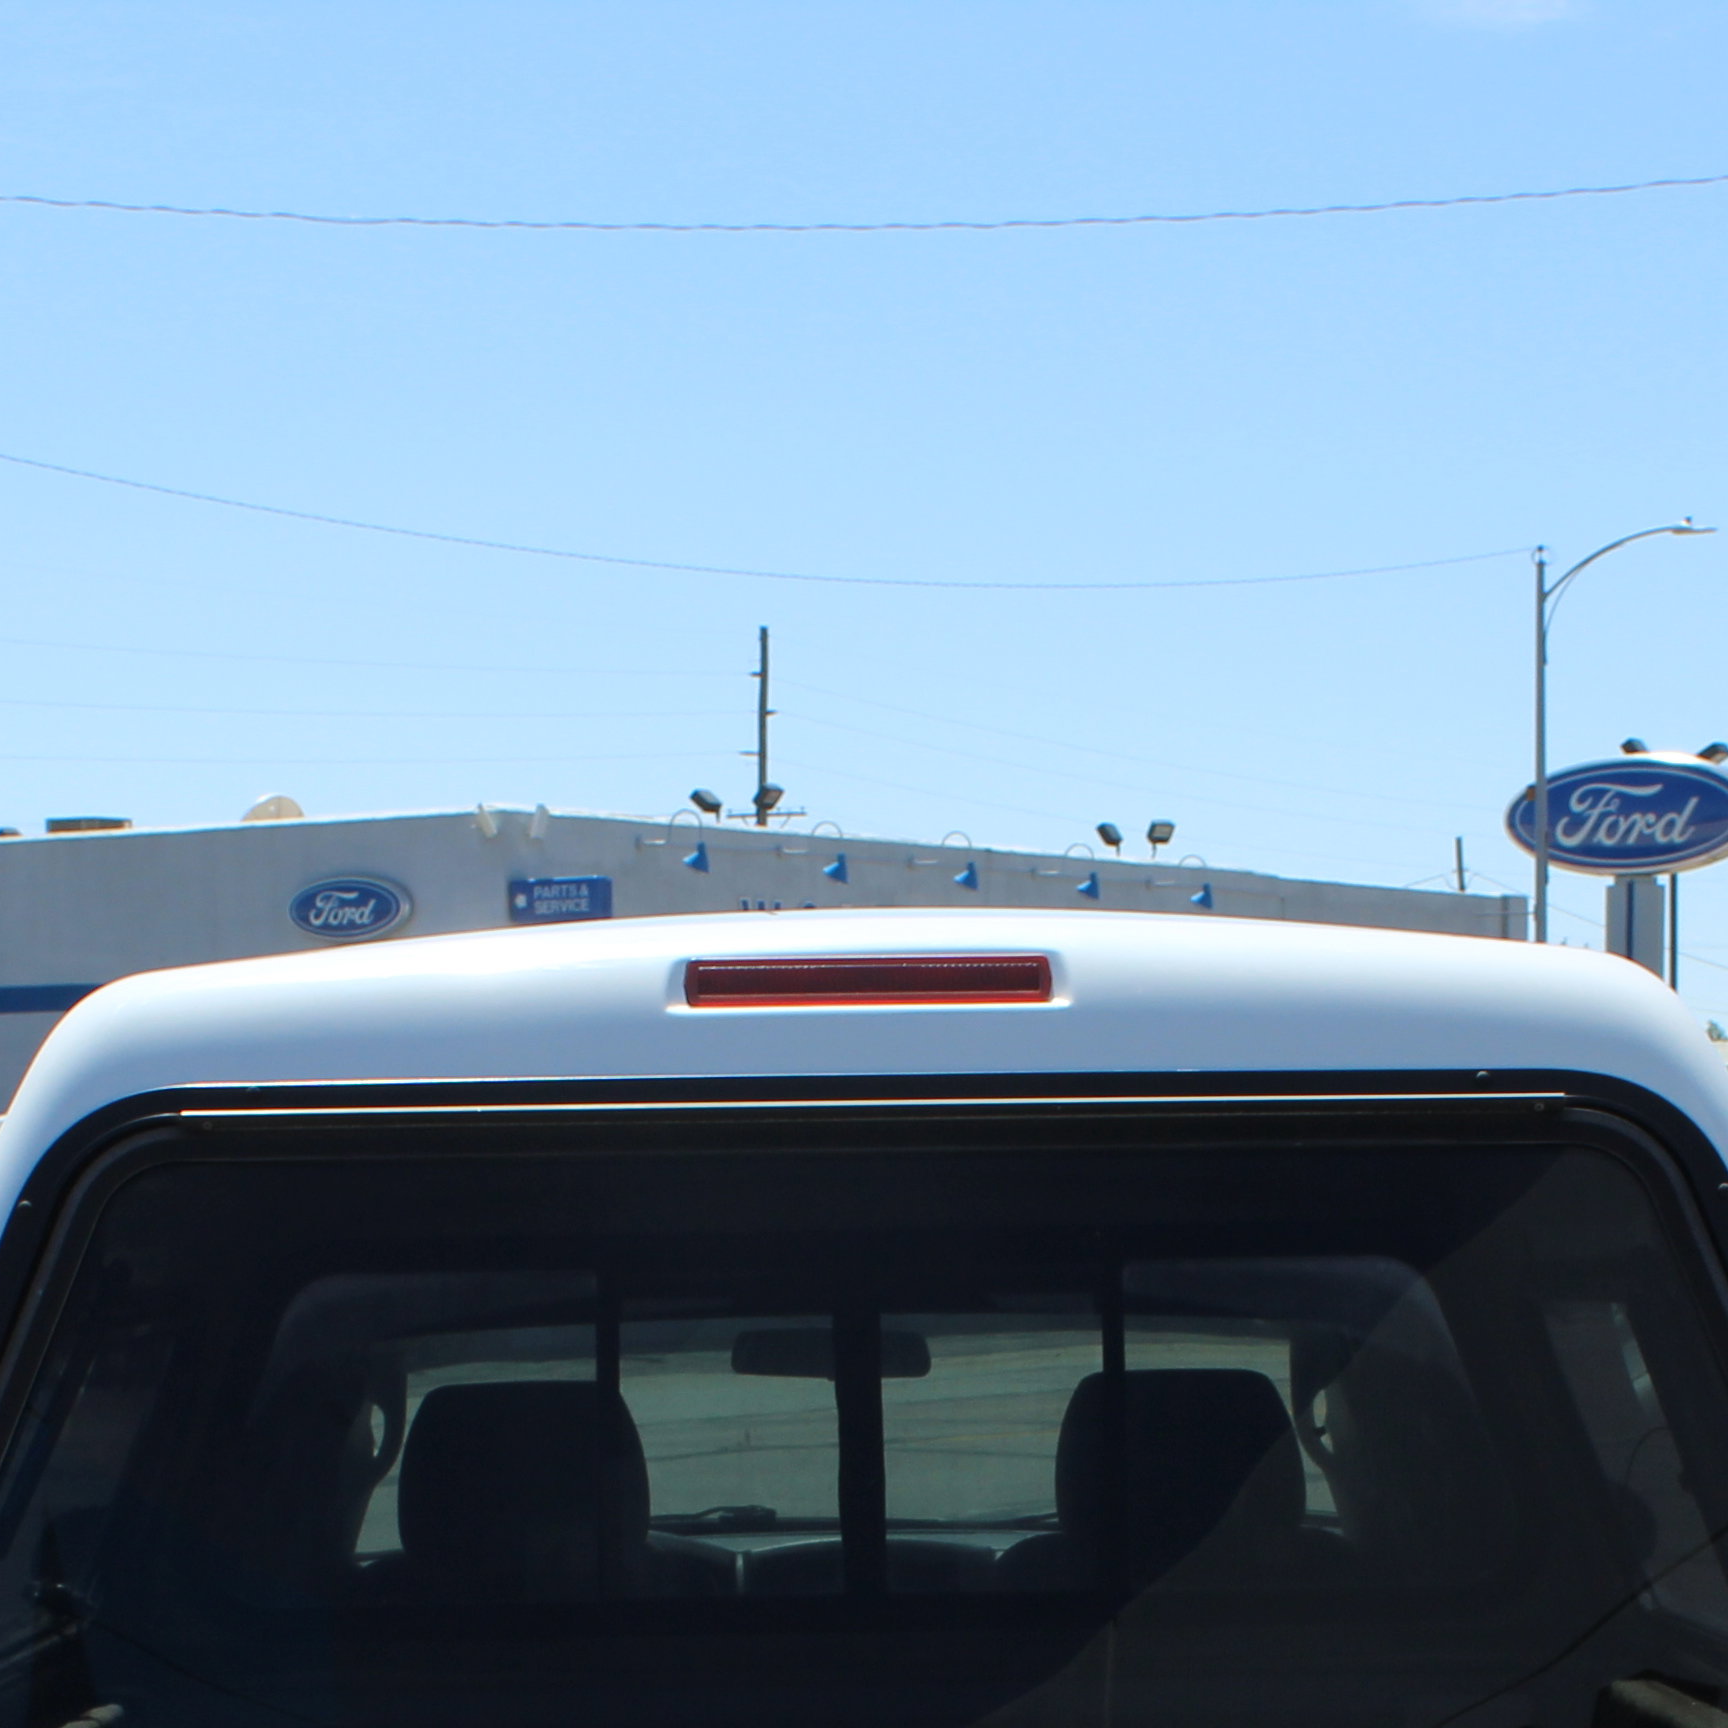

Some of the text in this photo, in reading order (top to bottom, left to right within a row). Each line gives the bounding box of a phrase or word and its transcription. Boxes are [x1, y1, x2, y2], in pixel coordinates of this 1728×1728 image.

[1555, 782, 1699, 848] Ford
[533, 885, 577, 899] PARTS
[308, 889, 376, 926] Ford
[533, 898, 590, 915] SERVICE
